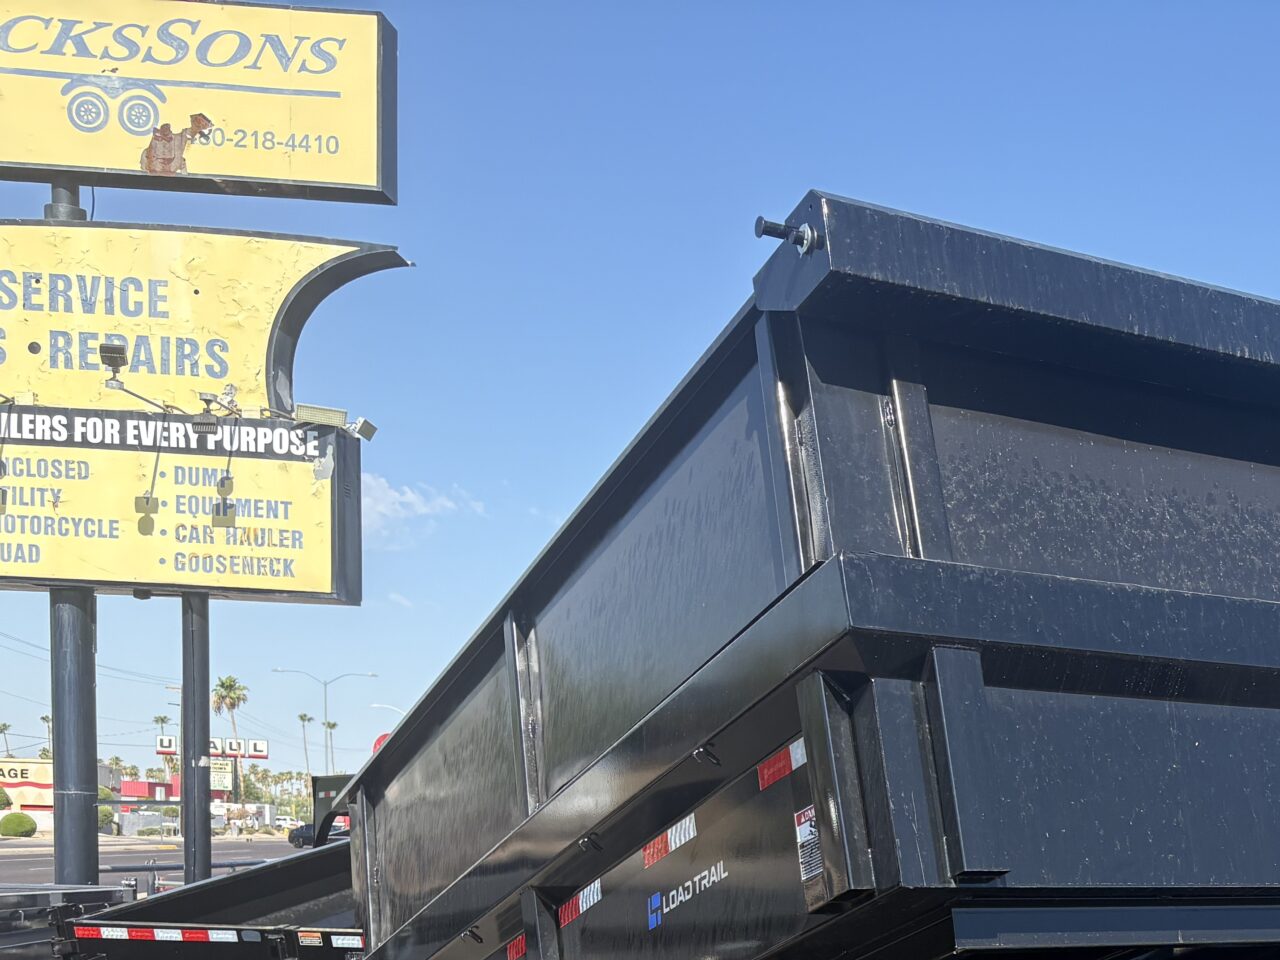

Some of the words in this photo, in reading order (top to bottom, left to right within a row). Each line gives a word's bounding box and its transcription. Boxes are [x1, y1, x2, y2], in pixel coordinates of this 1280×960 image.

[0, 270, 169, 318] SERVICE
[74, 416, 120, 444] FOR
[126, 419, 200, 449] EVERY
[207, 425, 320, 457] PURPOSE
[175, 494, 293, 520] EQUIPMENT
[0, 514, 119, 539] OTORCYCLE
[175, 523, 215, 544] CAR
[225, 527, 304, 550] HAULER
[0, 543, 40, 563] UAD
[174, 552, 296, 578] GOOSENECK
[662, 880, 693, 914] LOAD
[693, 860, 729, 894] TRAIL
